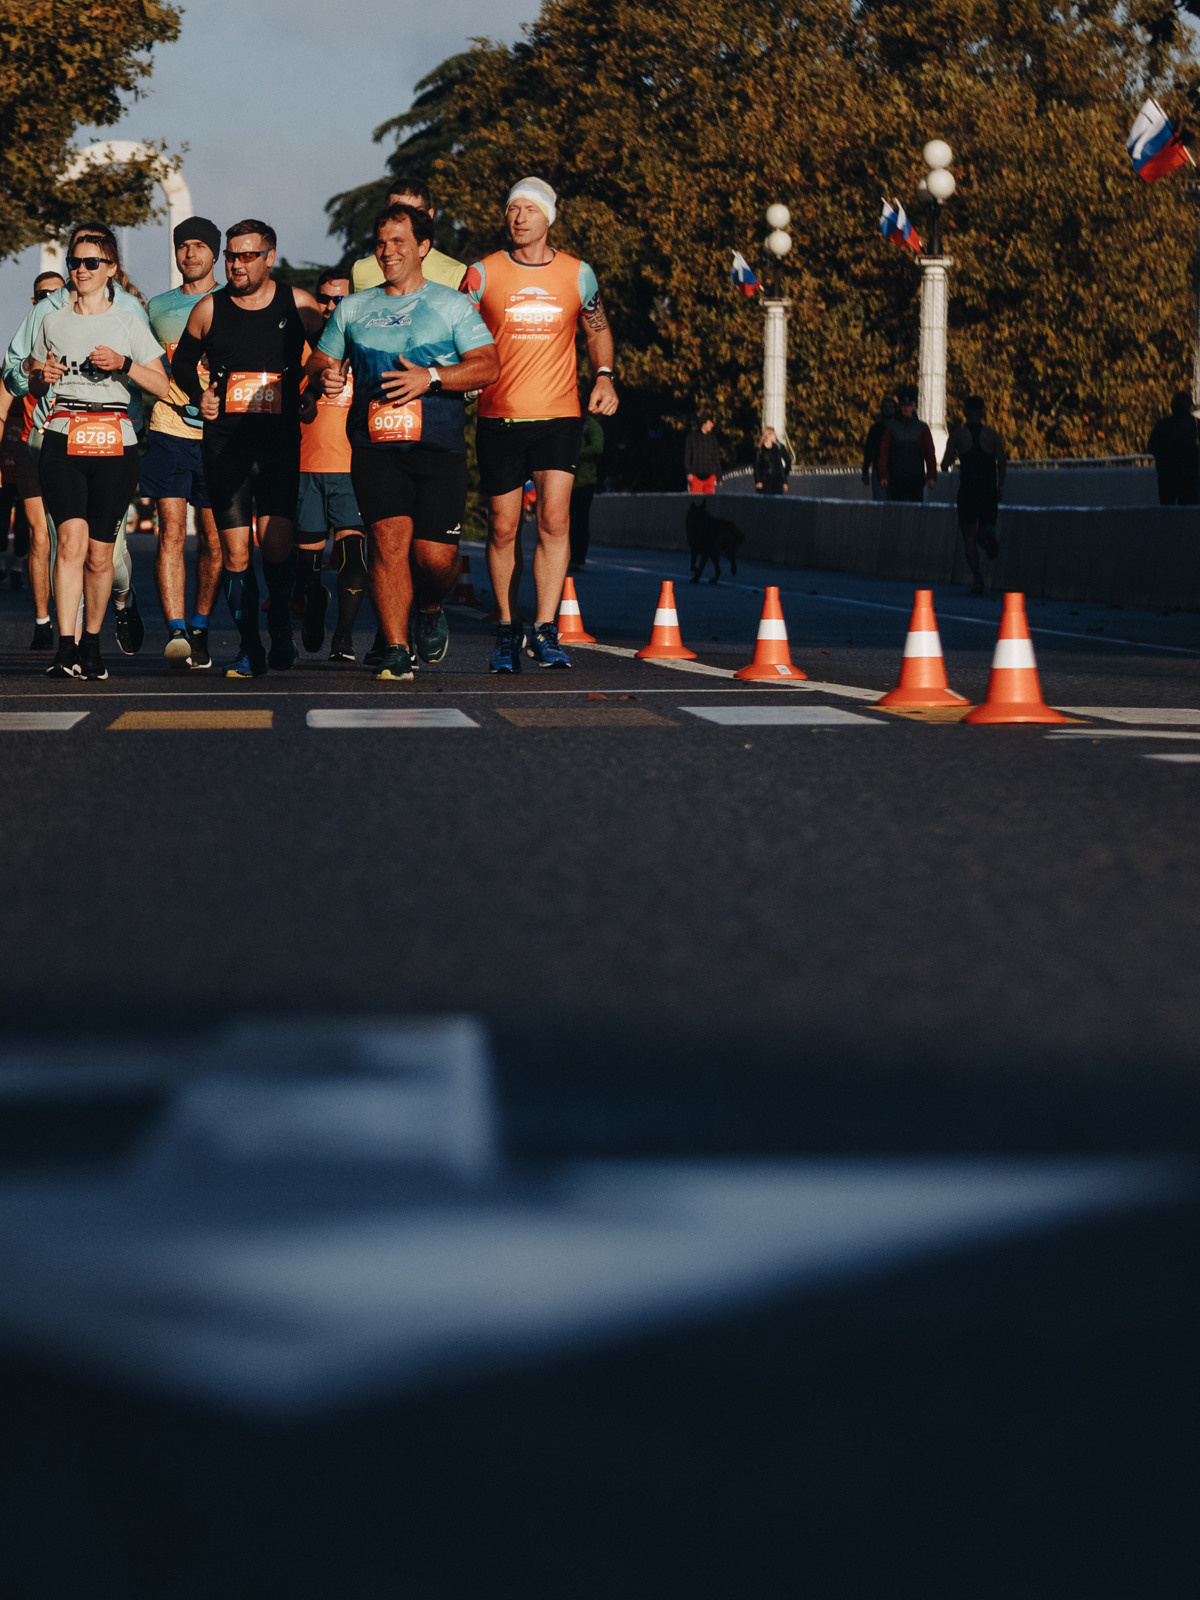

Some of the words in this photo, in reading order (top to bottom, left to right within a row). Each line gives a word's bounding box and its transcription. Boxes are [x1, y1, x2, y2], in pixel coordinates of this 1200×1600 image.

[233, 387, 274, 402] 8288
[374, 414, 413, 430] 9073
[76, 430, 116, 445] 8785
